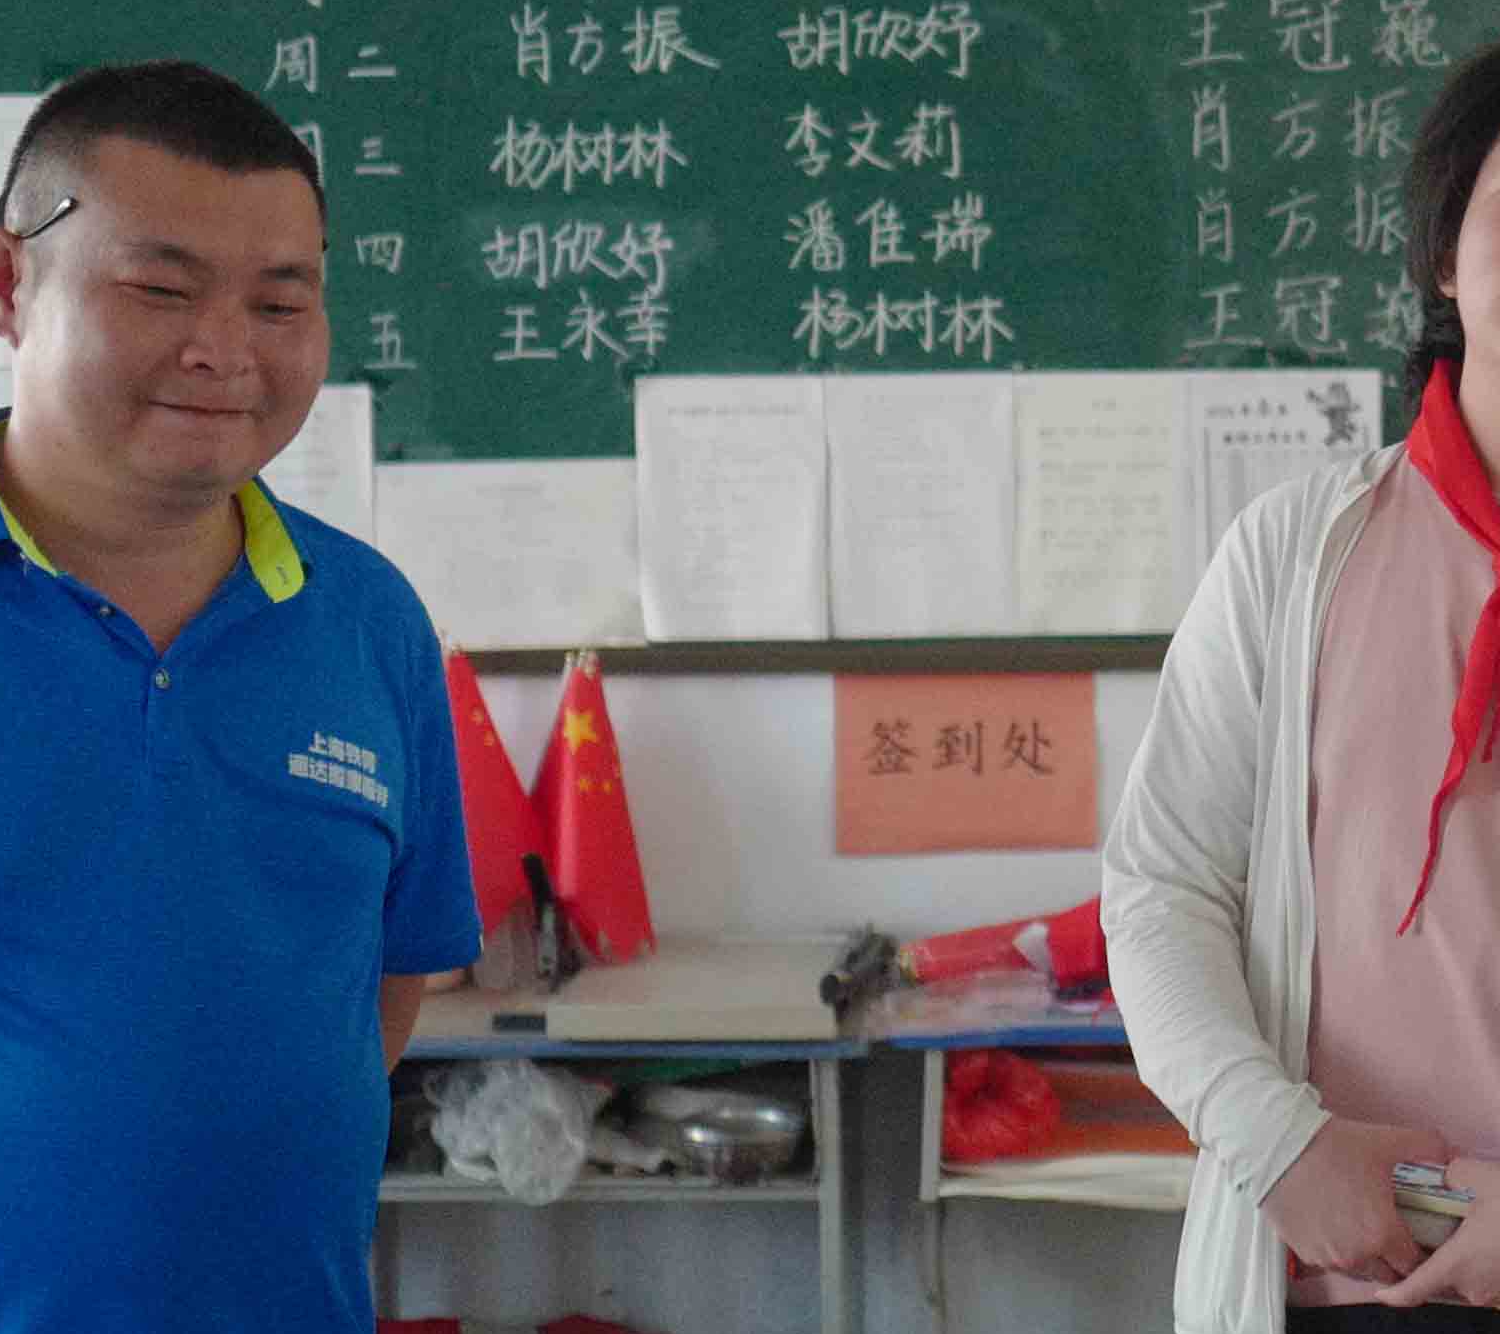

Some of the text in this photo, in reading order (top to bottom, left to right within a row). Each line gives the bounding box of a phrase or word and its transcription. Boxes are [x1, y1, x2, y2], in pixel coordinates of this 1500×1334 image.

[264, 36, 398, 94] 周二
[508, 1, 723, 85] 肖方振
[488, 113, 689, 194] 杨树林
[784, 101, 962, 179] 李文莉
[782, 190, 994, 273] 潘佳瑞
[493, 287, 671, 363] 王永幸
[792, 285, 1016, 363] 杨树林
[859, 717, 1056, 777] 签到处
